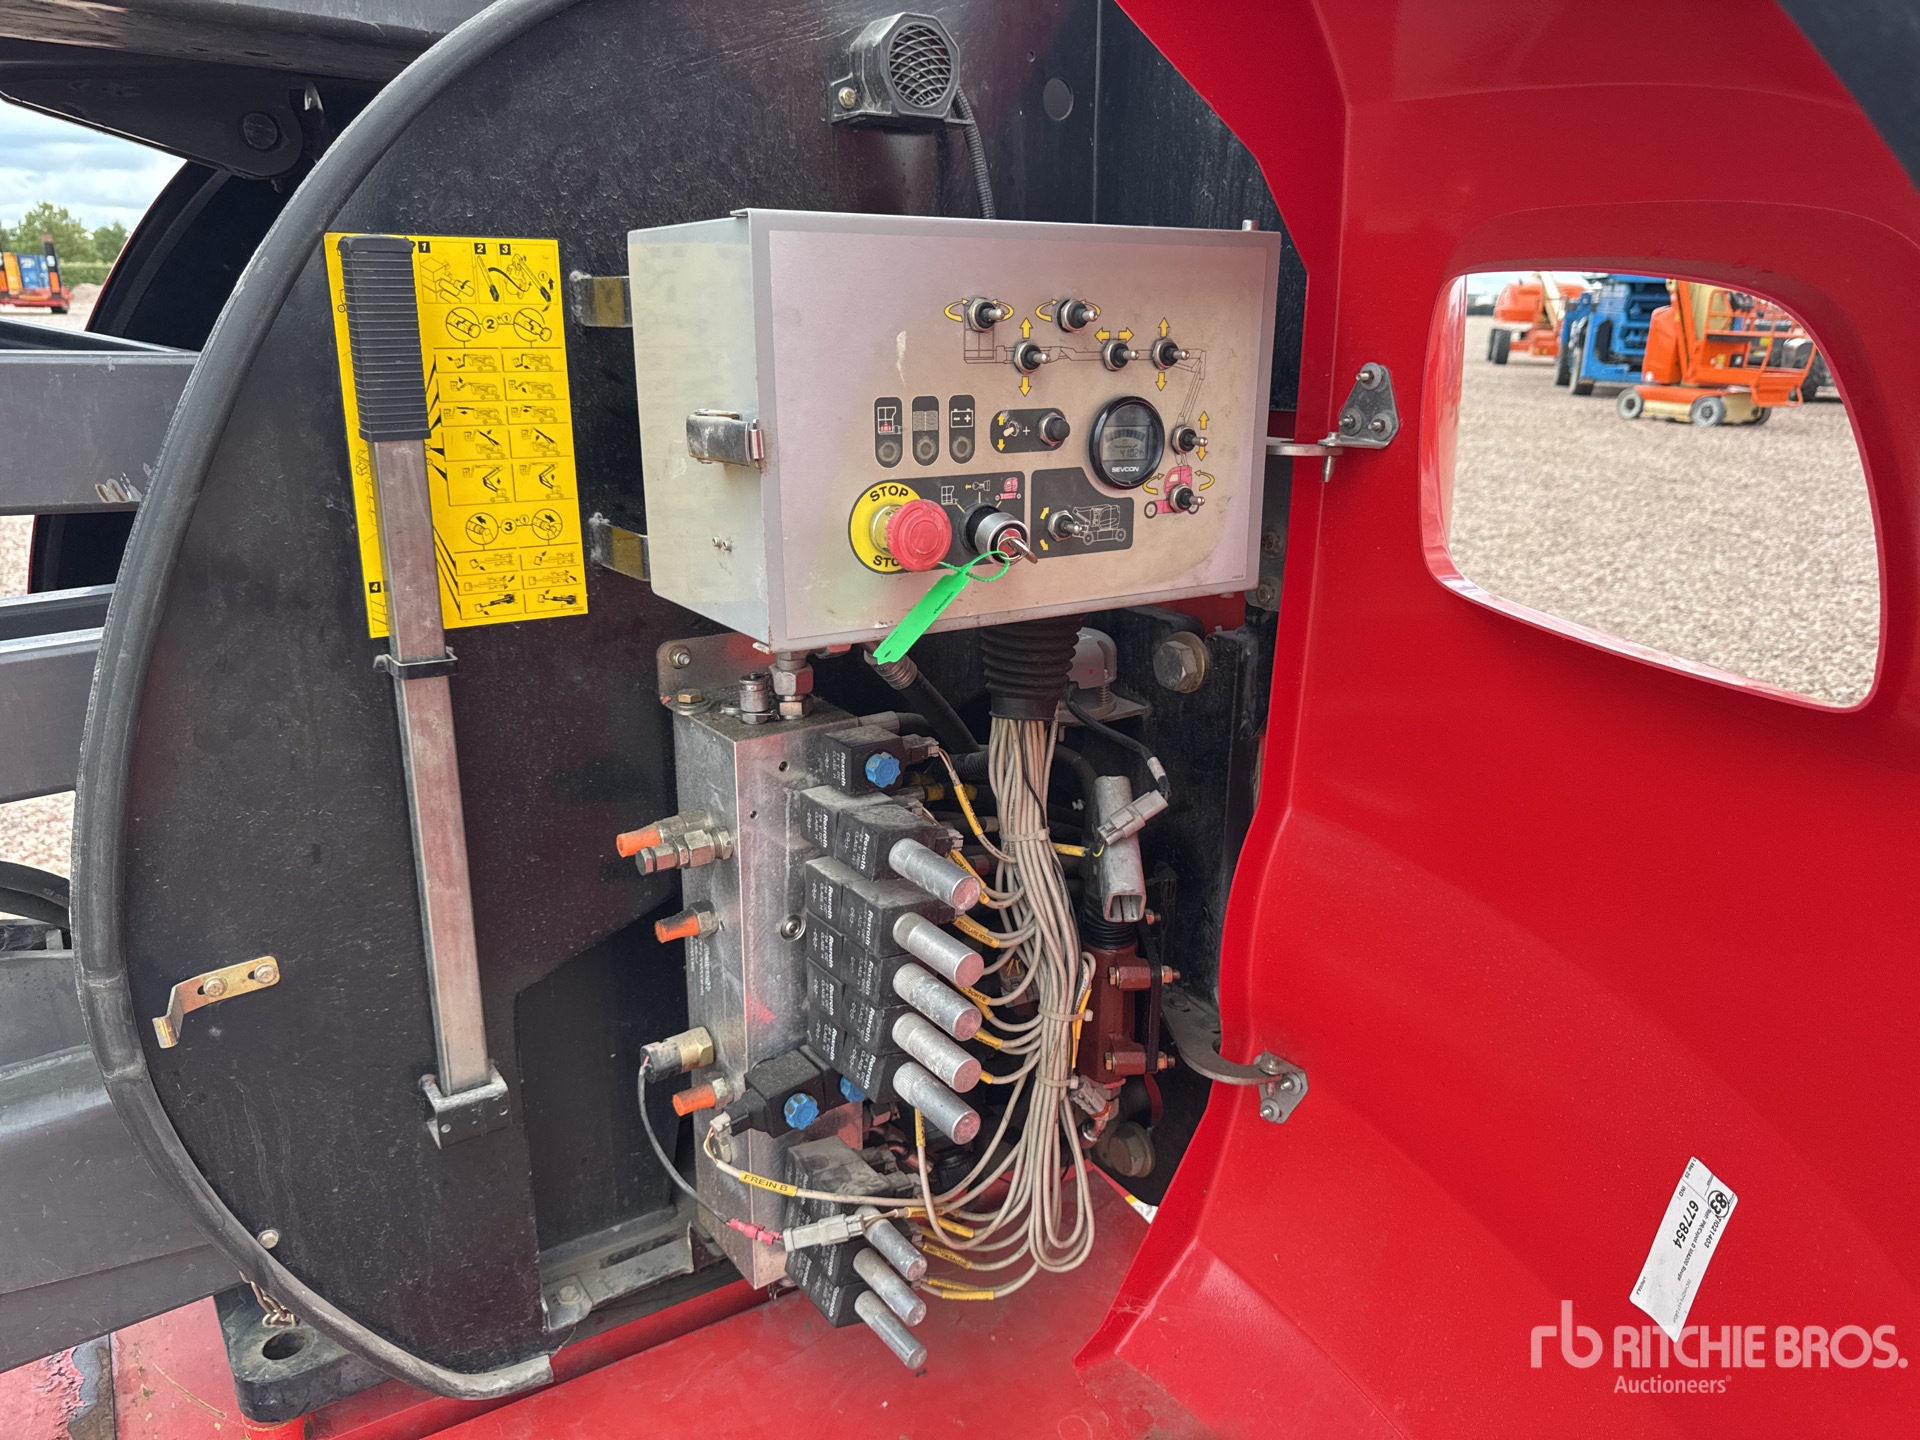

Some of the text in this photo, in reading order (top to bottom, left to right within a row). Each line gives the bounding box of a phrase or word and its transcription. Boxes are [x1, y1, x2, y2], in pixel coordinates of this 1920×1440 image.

[421, 242, 428, 252] 1
[477, 244, 484, 253] 2
[502, 244, 508, 254] 3
[486, 320, 495, 330] 2
[870, 485, 909, 502] STOP
[504, 522, 513, 531] 3
[873, 555, 900, 568] STO
[372, 583, 378, 592] 4
[860, 833, 870, 870] Rexroth
[865, 910, 874, 946] Rexroth
[865, 960, 874, 996] Rexroth
[864, 1008, 876, 1042] Rexroth
[864, 1054, 876, 1090] Rexroth
[744, 1174, 778, 1188] FREIN
[1678, 1186, 1686, 1198] IND
[1710, 1190, 1728, 1215] 83
[1672, 1200, 1699, 1249] 677854
